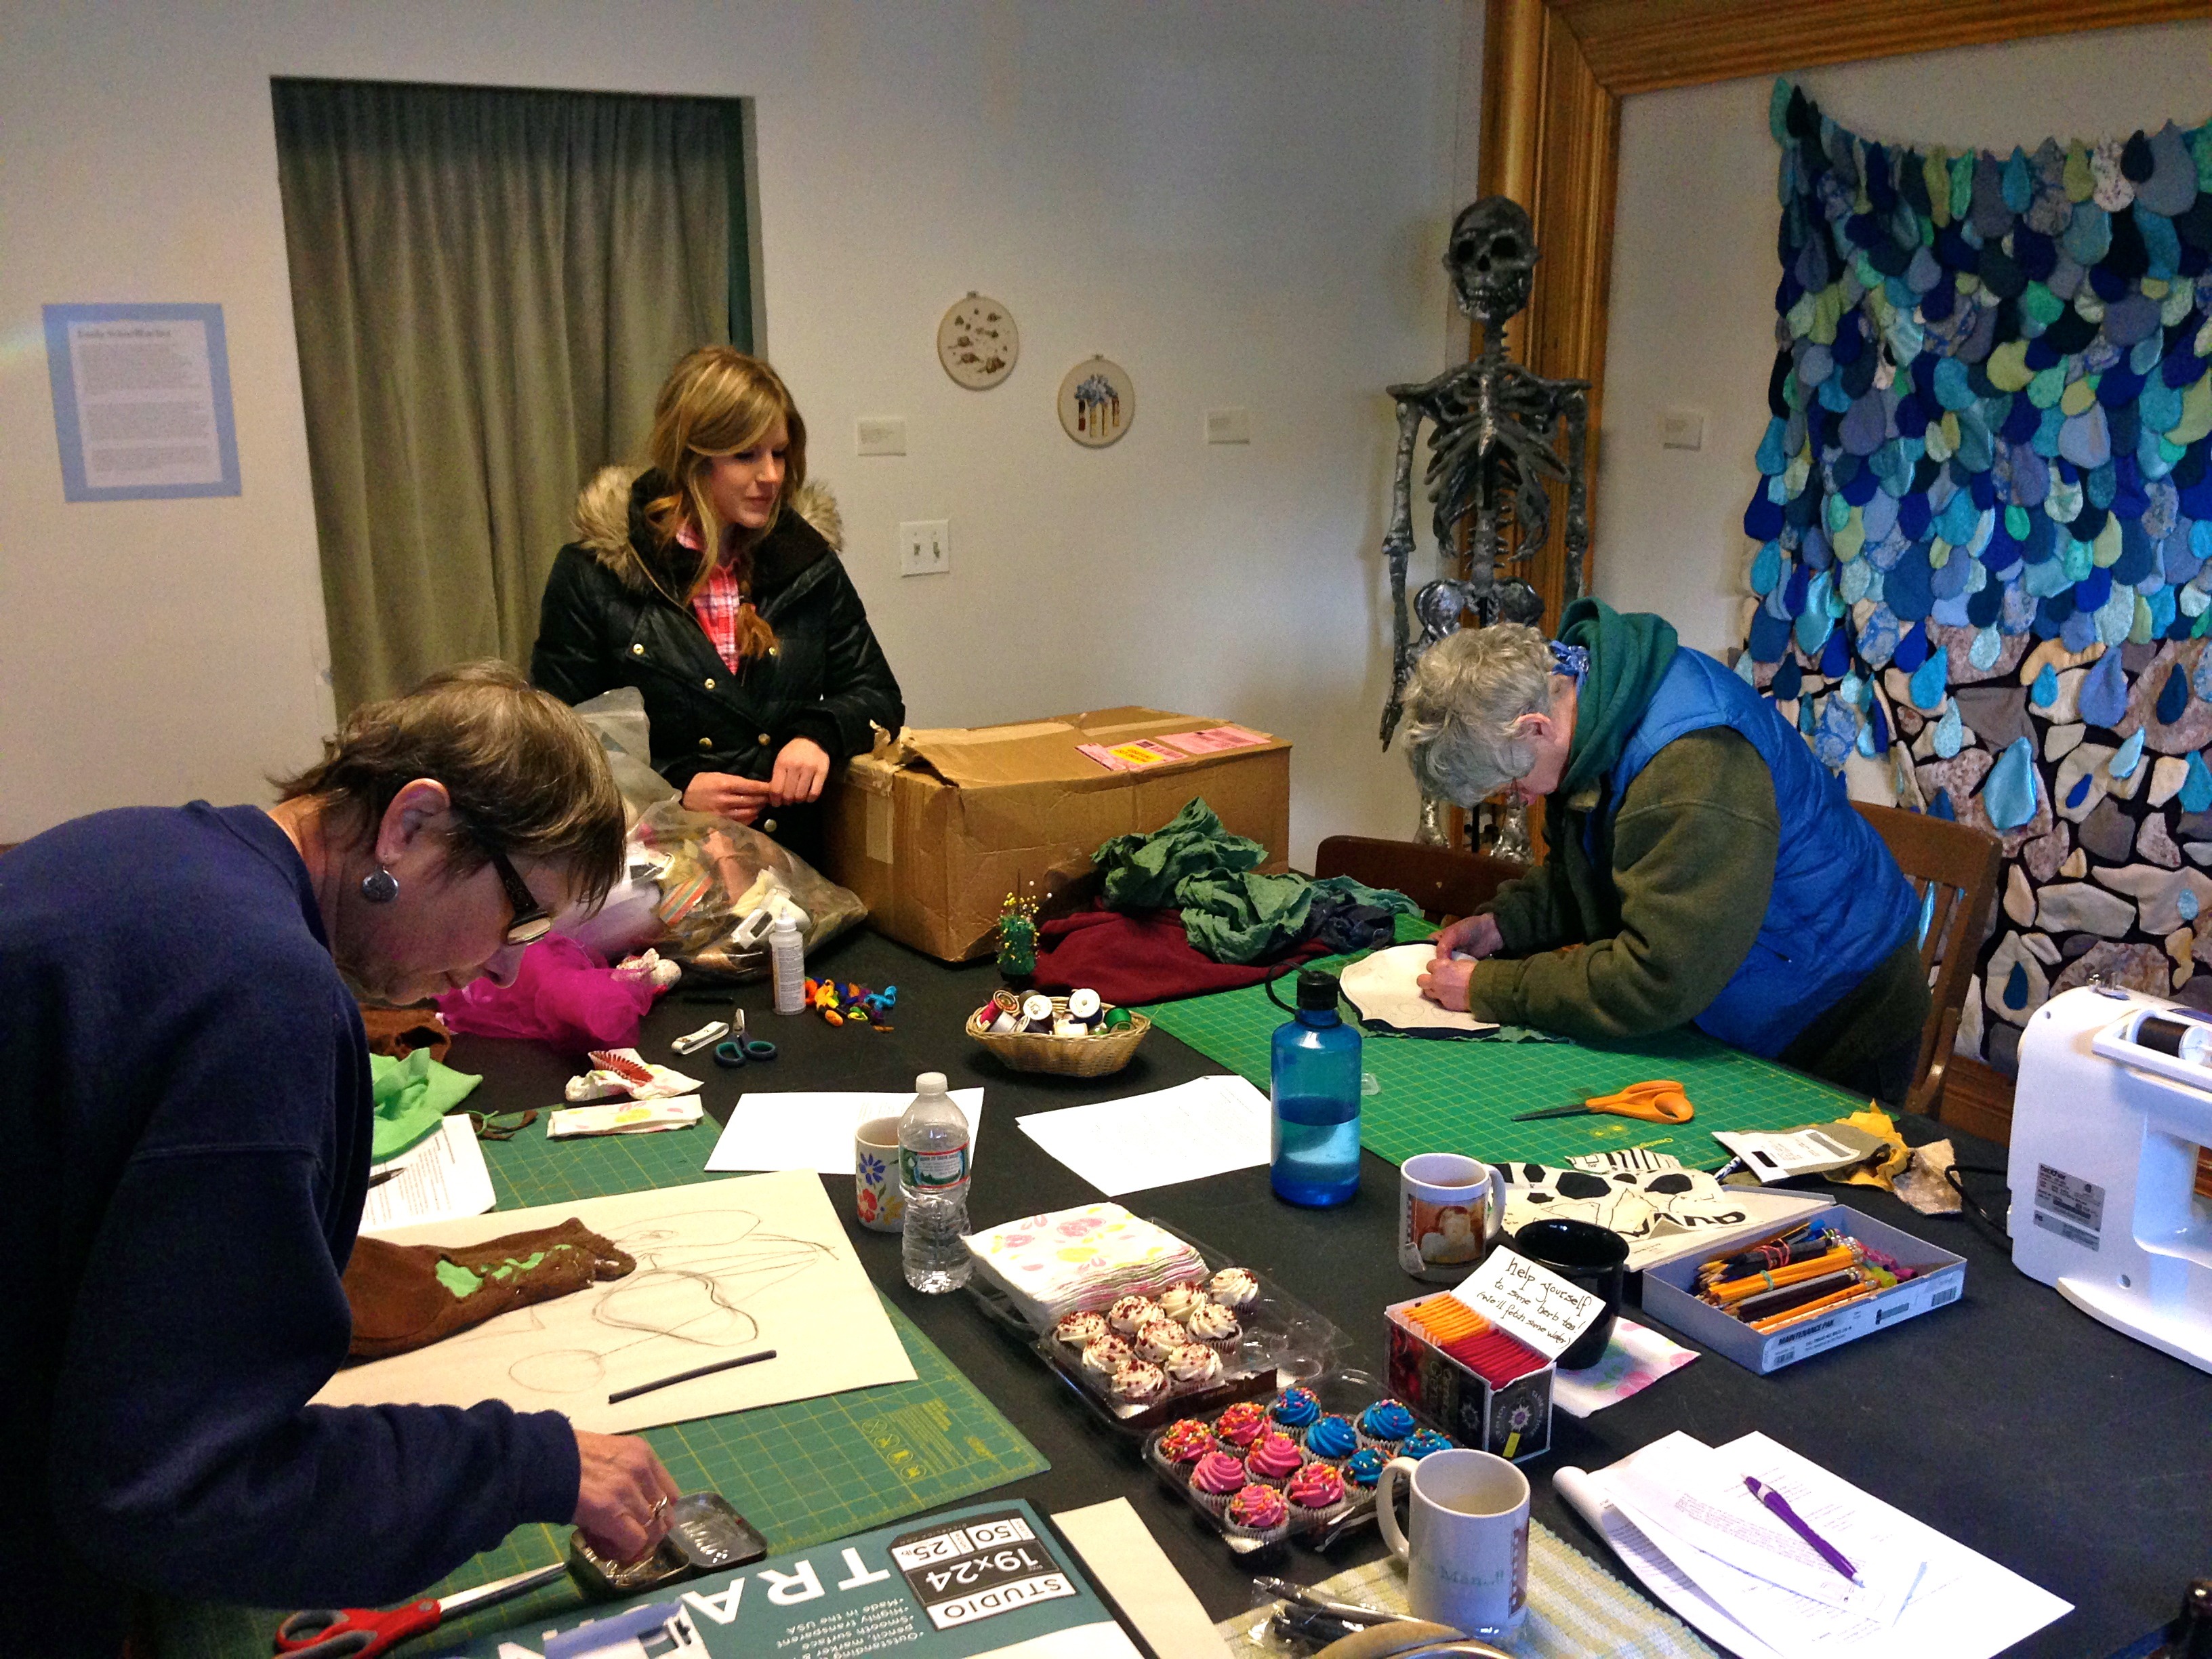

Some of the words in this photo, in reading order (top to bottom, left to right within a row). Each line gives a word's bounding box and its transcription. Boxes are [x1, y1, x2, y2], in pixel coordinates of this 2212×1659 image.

[1505, 1257, 1536, 1291] help
[1536, 1283, 1592, 1317] yourself
[1494, 1277, 1504, 1290] to
[1507, 1290, 1531, 1305] some
[1537, 1300, 1559, 1321] herb
[1500, 1304, 1525, 1322] fetch
[1525, 1319, 1547, 1332] some
[975, 1525, 1012, 1542] 50
[926, 1548, 1039, 1593] 19x24
[863, 1599, 899, 1613] Made
[944, 1578, 1062, 1618] STUDIO
[820, 1614, 842, 1625] the
[846, 1609, 859, 1618] in
[777, 1620, 857, 1649] transparent
[786, 1620, 816, 1635] USA
[856, 1616, 909, 1635] Smooth
[802, 1631, 853, 1651] surface
[817, 1637, 864, 1658] marker
